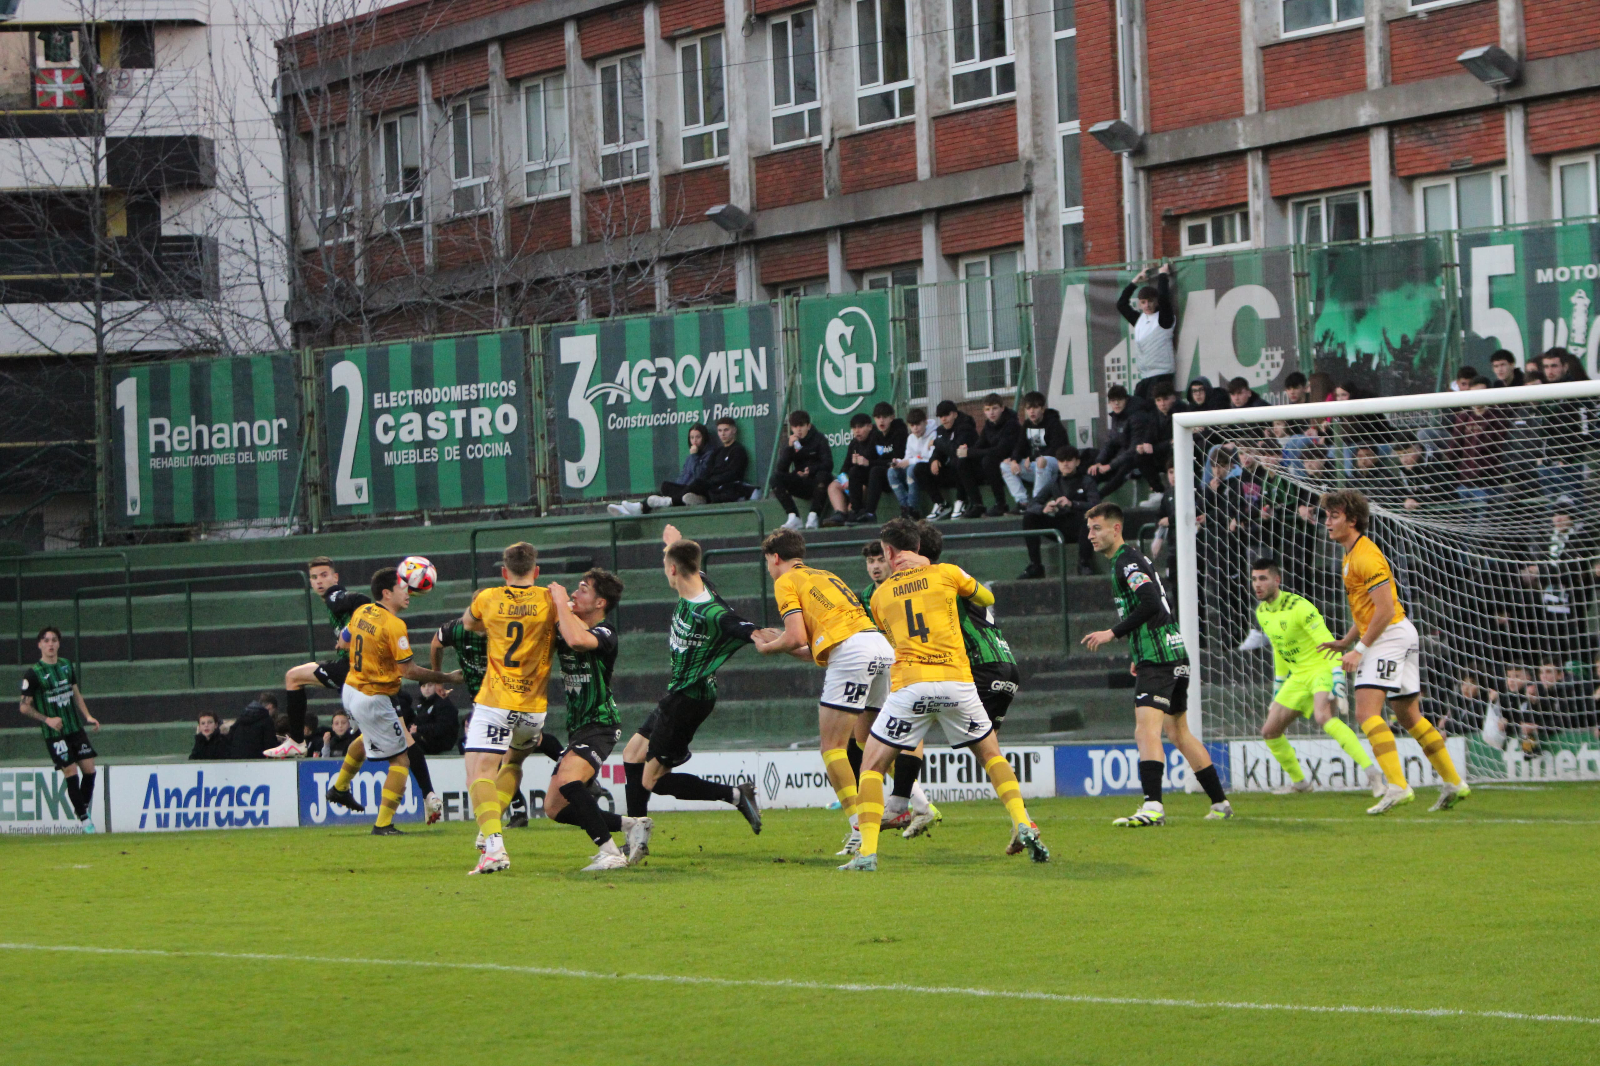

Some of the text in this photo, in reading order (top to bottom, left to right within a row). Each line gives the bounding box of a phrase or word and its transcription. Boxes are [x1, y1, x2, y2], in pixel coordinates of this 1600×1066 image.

[1471, 244, 1525, 372] 5
[606, 346, 768, 405] AGROMEN
[1047, 283, 1099, 450] 4
[374, 380, 517, 409] ELECTRODOMESTICOS
[560, 334, 601, 489] 3
[148, 415, 289, 453] Rehanor
[331, 360, 369, 506] 2
[607, 402, 770, 430] Construcciones y Reformas
[116, 377, 141, 516] 1
[149, 448, 289, 470] REHABILITACIONES DEL NORTE
[384, 440, 513, 467] MUEBLES DE COCINA
[893, 577, 929, 598] RAMIRO
[904, 598, 931, 644] 4
[354, 634, 363, 673] 8
[503, 621, 524, 668] 2
[53, 740, 69, 755] 20
[393, 721, 402, 737] 8
[139, 770, 270, 829] Andrasa
